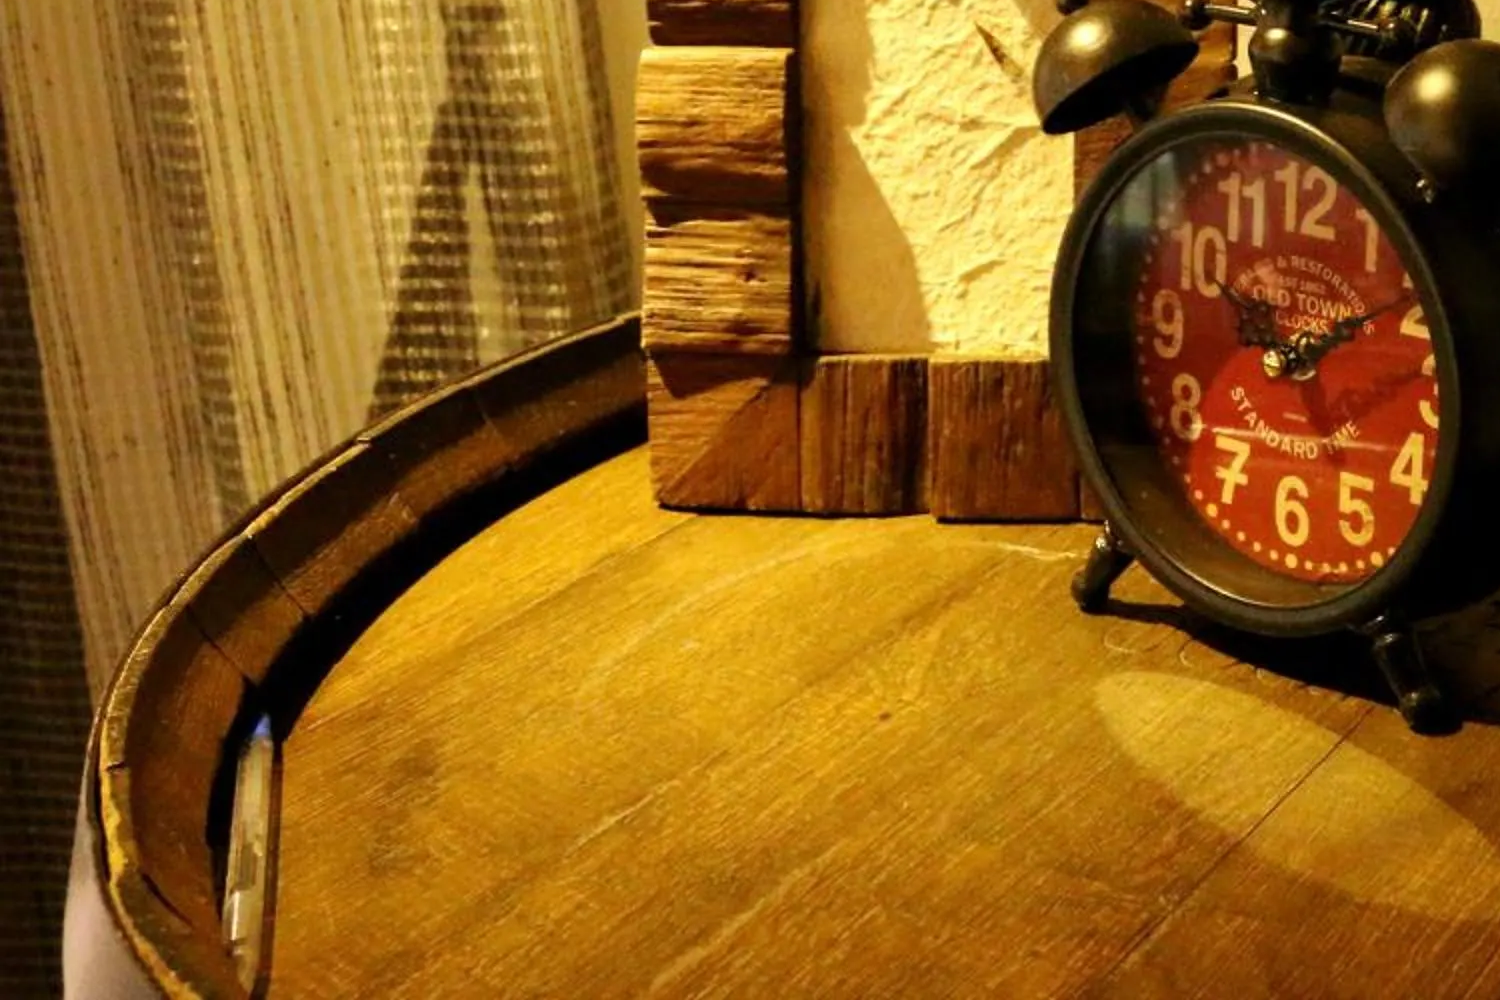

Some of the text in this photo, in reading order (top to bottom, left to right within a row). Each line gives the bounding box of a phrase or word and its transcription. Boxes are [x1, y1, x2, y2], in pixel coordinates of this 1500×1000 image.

[1218, 171, 1266, 247] 11
[1274, 160, 1338, 242] 12
[1171, 221, 1227, 298] 10
[1355, 207, 1380, 273] 1
[1152, 289, 1185, 360] 9
[1252, 284, 1351, 323] OLD TOWN
[1275, 309, 1330, 335] CLOCKS
[1170, 372, 1206, 441] 8
[1231, 385, 1360, 460] STANDARD TIME
[1214, 436, 1252, 505] 7
[1389, 431, 1430, 506] 4
[1274, 475, 1310, 547] 6
[1338, 471, 1375, 547] 5
